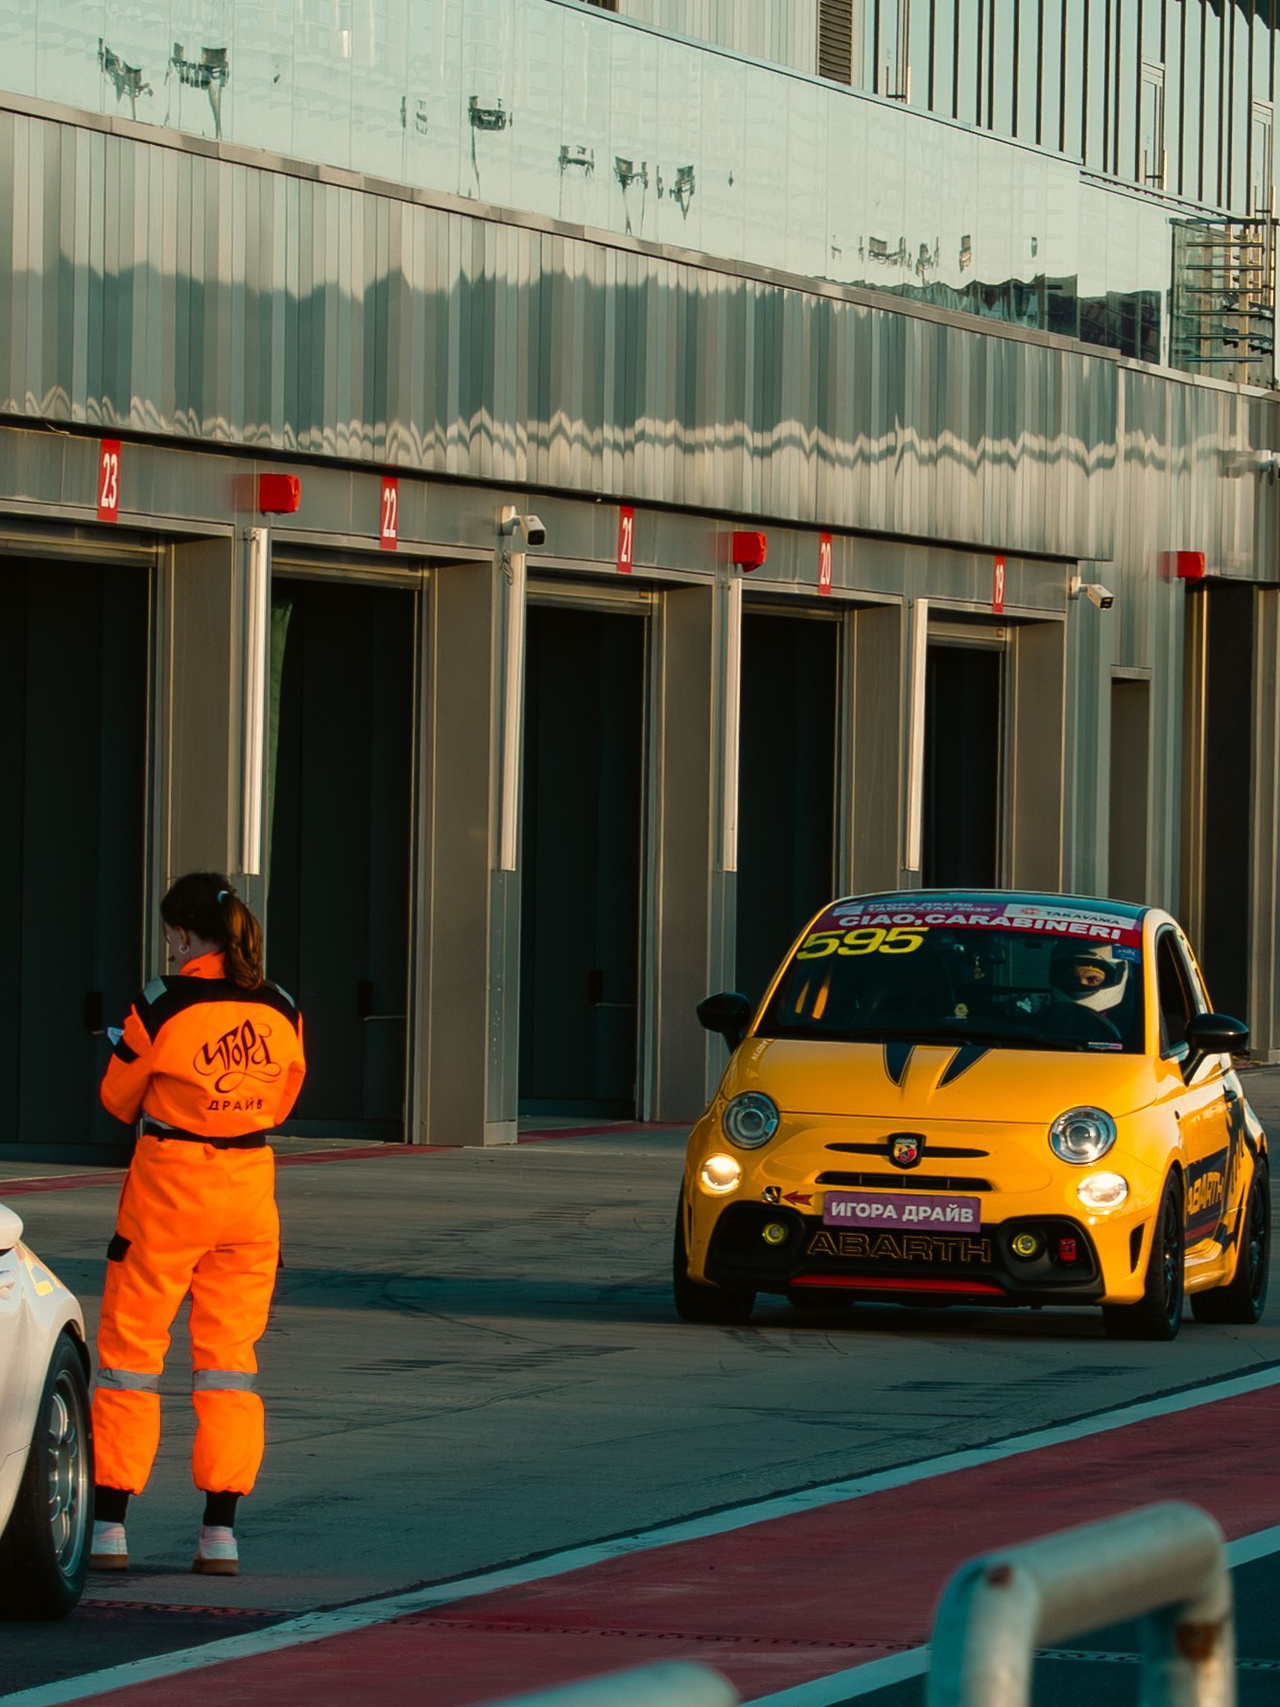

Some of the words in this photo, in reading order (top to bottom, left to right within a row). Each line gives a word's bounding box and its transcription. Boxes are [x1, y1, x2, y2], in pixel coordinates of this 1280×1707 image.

[101, 452, 118, 508] 23
[382, 487, 398, 538] 22
[621, 516, 633, 563] 21
[820, 542, 831, 585] 20
[1046, 911, 1121, 926] TAKAYAMA
[797, 927, 930, 960] 595
[831, 1201, 898, 1219] ИГОРА
[901, 1203, 974, 1223] ДРАЙВ
[807, 1231, 992, 1264] ABARTH
